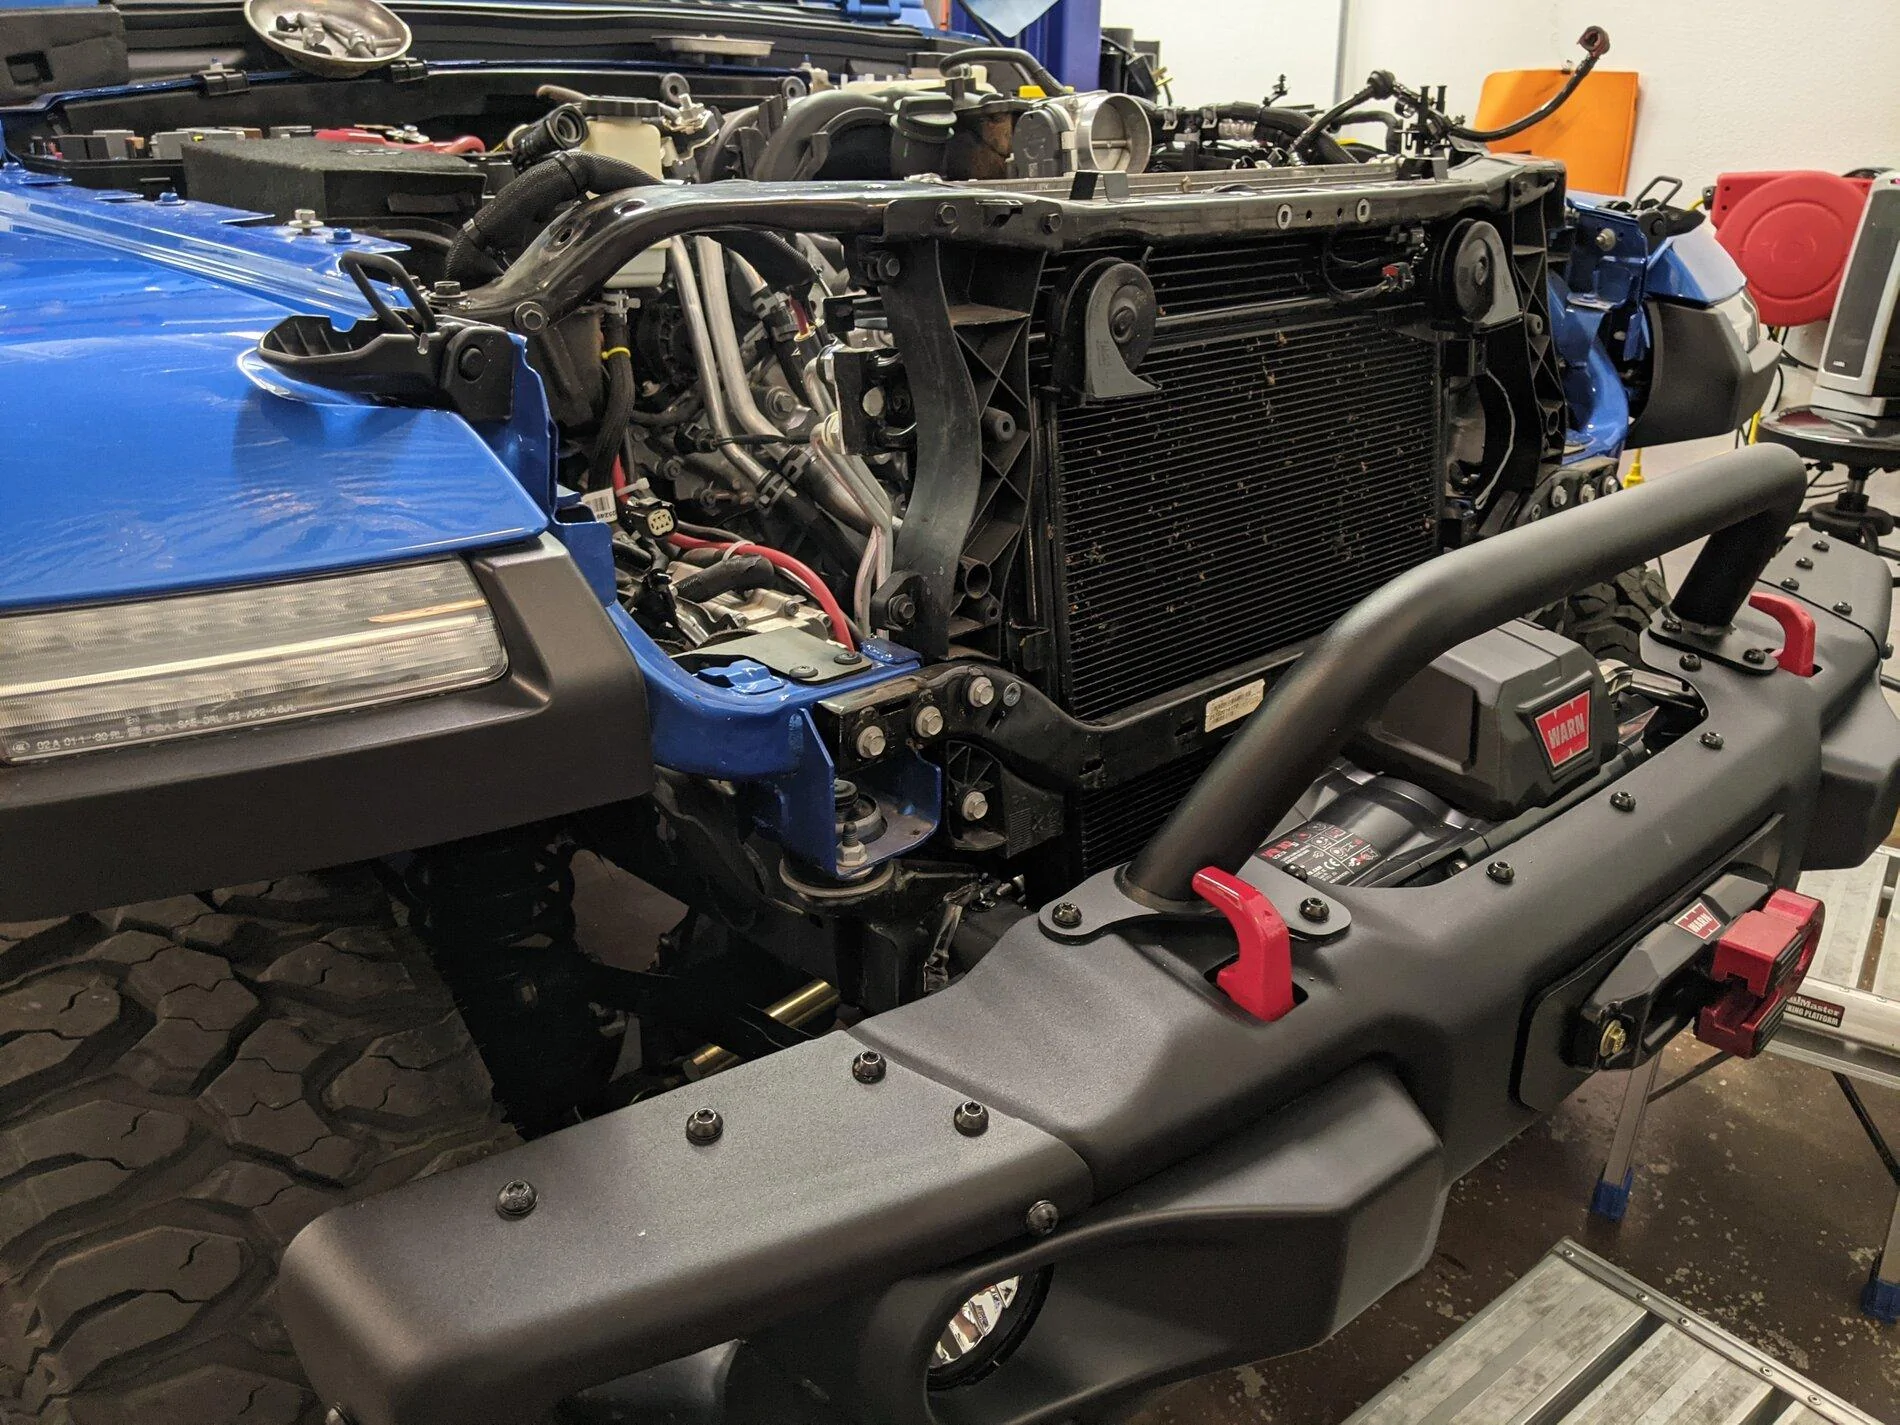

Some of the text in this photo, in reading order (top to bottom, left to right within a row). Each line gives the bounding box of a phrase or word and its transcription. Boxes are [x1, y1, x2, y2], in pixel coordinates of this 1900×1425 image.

[1547, 712, 1585, 749] WARN
[1687, 912, 1713, 933] WARN
[1803, 1009, 1839, 1026] PLATFORM
